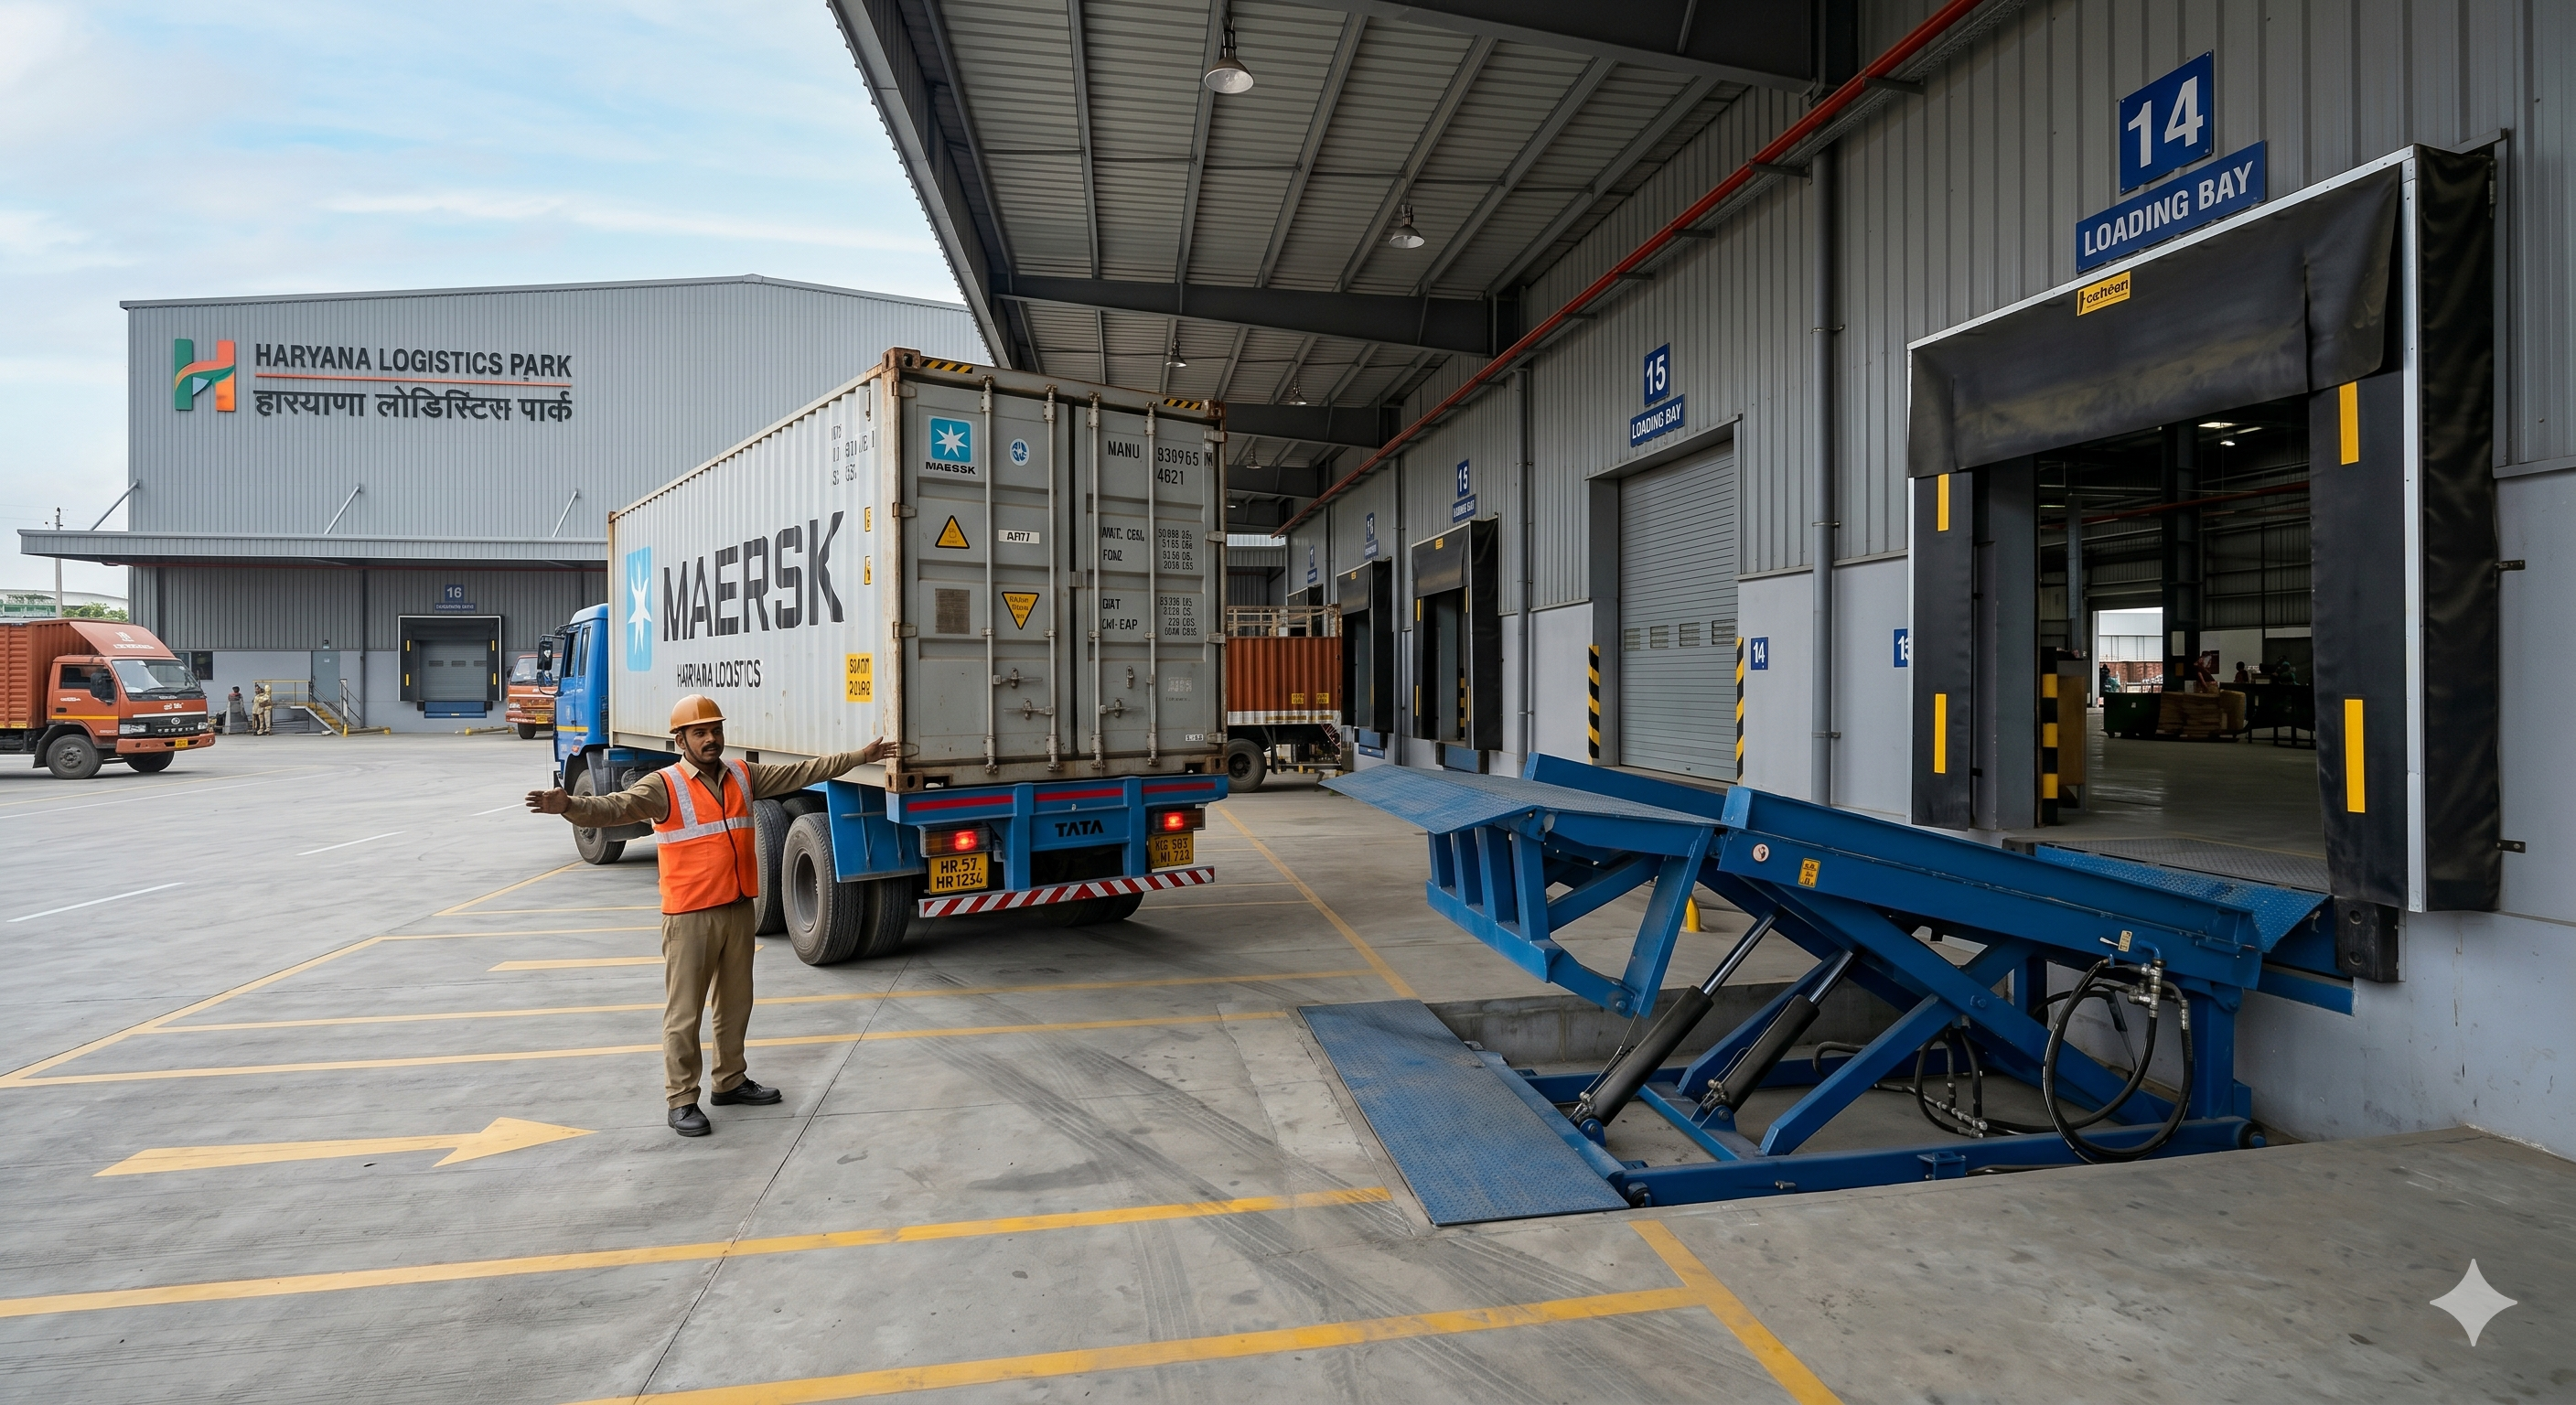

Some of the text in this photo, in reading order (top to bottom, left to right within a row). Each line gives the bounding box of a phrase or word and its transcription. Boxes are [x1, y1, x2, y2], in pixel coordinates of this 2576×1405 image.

[2128, 75, 2204, 168] 14
[2084, 160, 2254, 257] LOADING BAY
[255, 343, 573, 378] HARYANA LOGISTICS PARK
[1647, 354, 1666, 395] 15
[517, 390, 573, 423] पार्क
[1632, 402, 1682, 439] LOADING BAY
[1108, 440, 1140, 458] MANU
[925, 461, 977, 475] MAESSK
[1157, 468, 1184, 485] 4621
[447, 586, 462, 598] 16
[663, 511, 844, 642] MAERSK
[1753, 641, 1766, 663] 14
[1055, 820, 1104, 837] TATA
